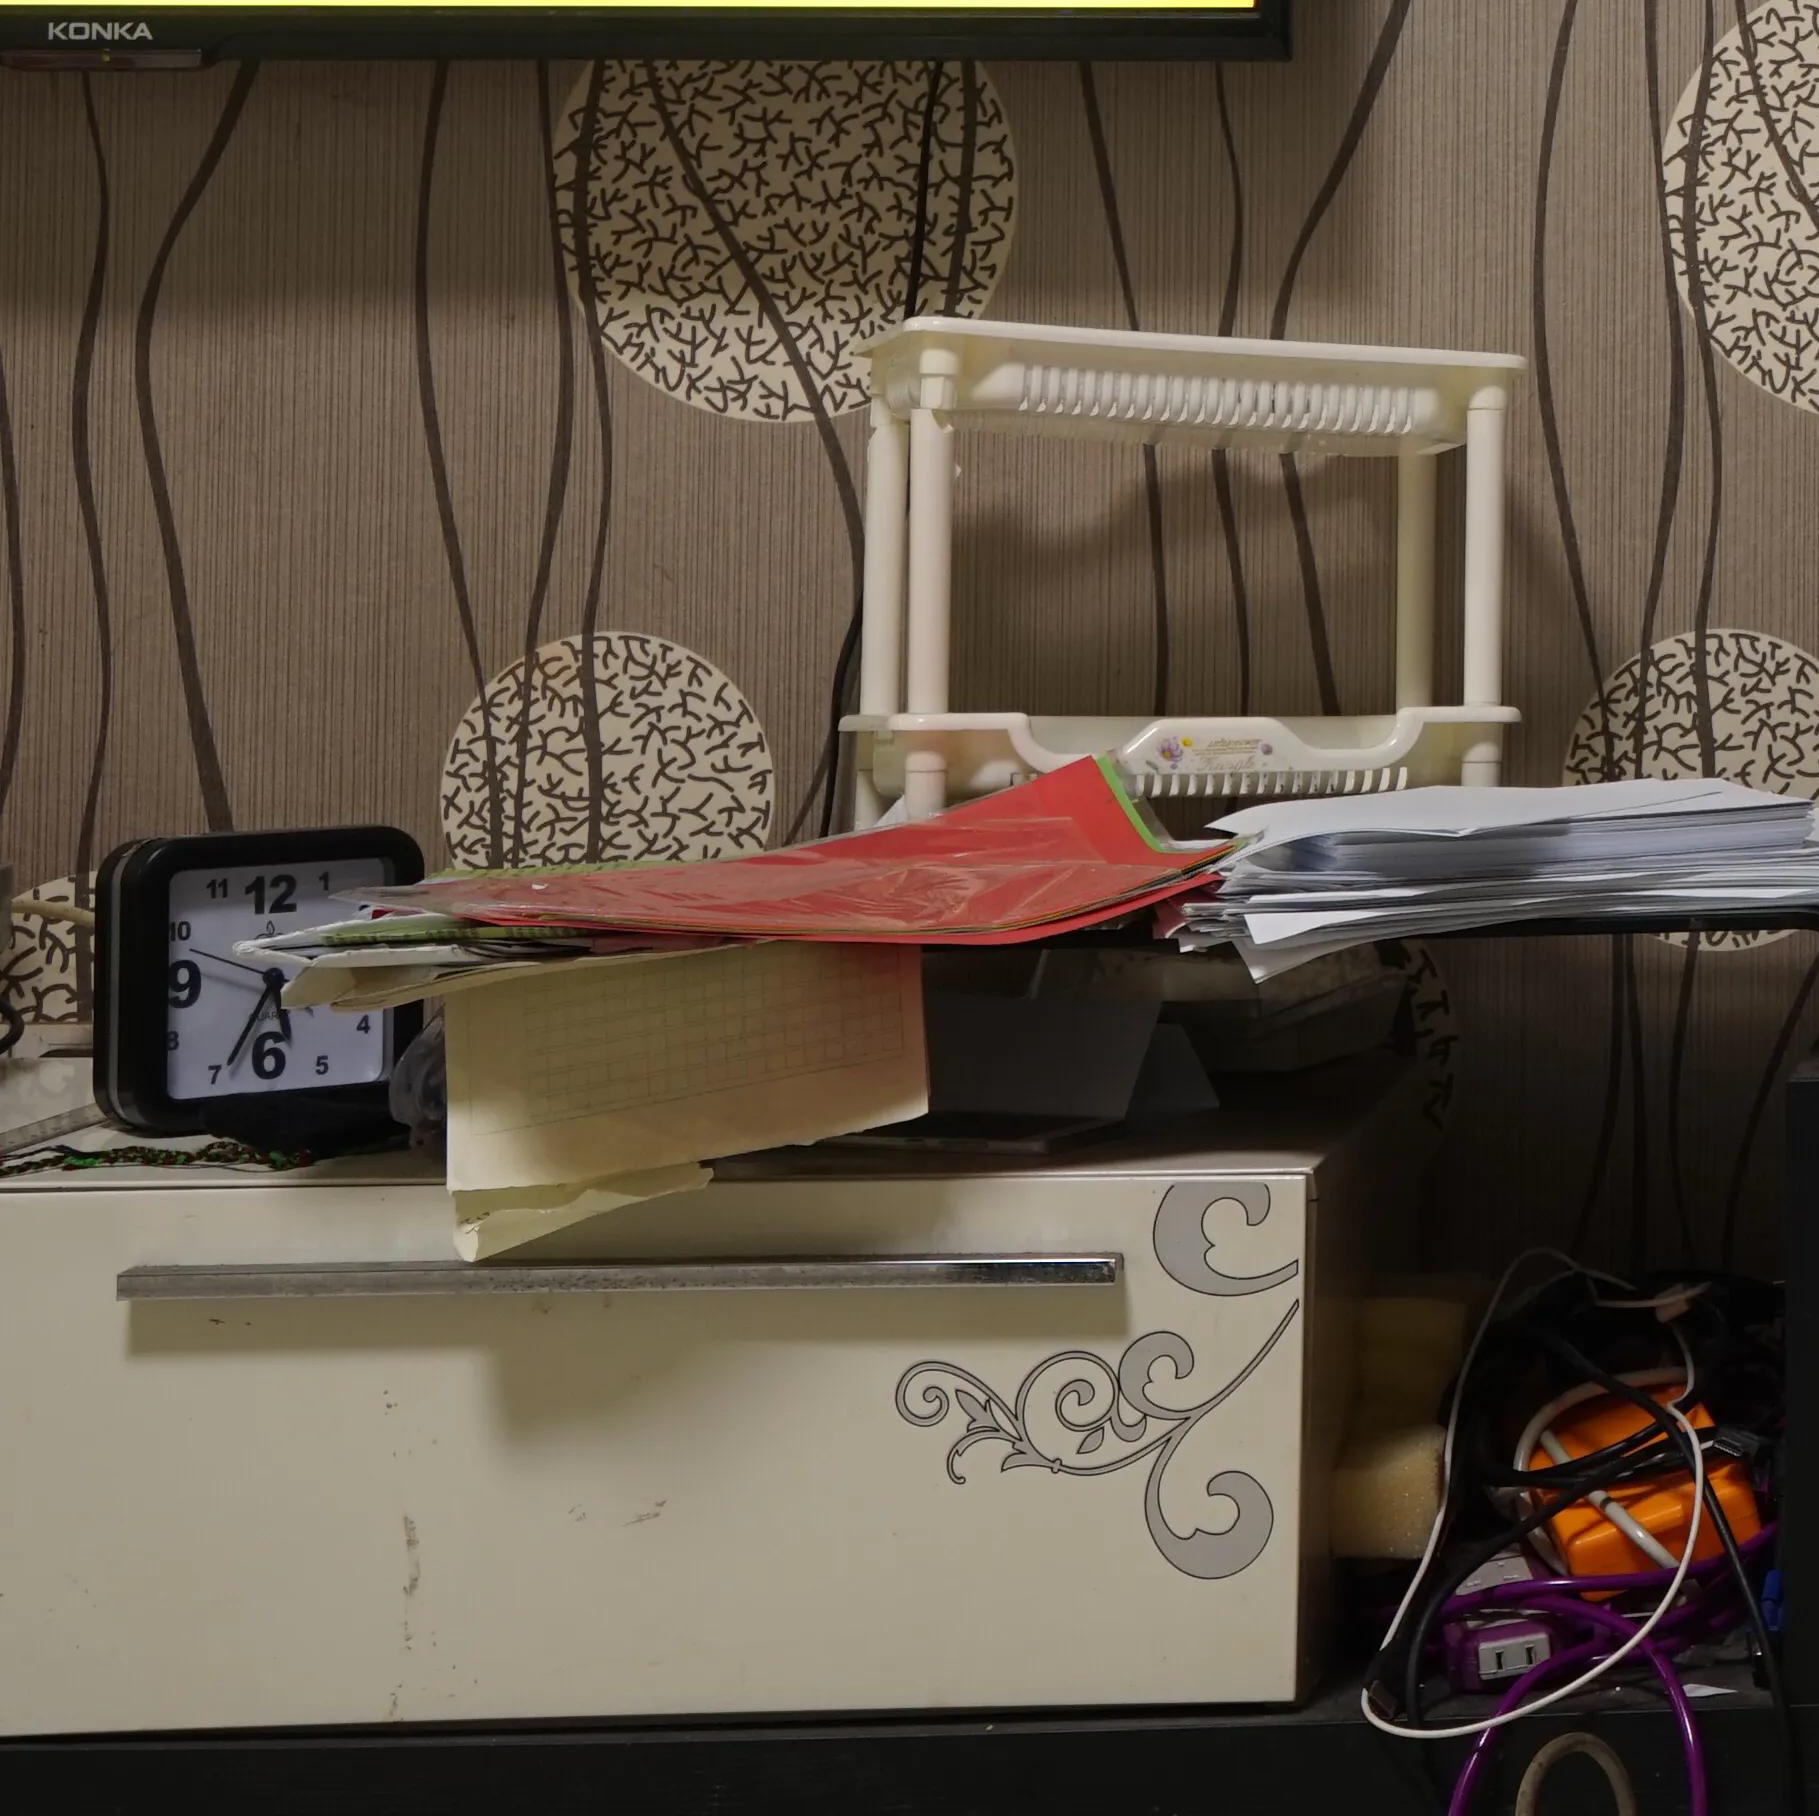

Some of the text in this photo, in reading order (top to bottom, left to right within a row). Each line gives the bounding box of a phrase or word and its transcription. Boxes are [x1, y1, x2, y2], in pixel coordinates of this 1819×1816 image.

[47, 21, 153, 41] KONKA
[206, 878, 228, 900] 11
[318, 872, 330, 891] 1
[245, 874, 298, 915] 12
[169, 920, 191, 942] 10
[168, 959, 201, 1009] 9
[356, 1014, 371, 1034] 4
[168, 1031, 180, 1052] 8
[252, 1031, 286, 1080] 6
[315, 1055, 329, 1075] 5
[208, 1064, 222, 1085] 7
